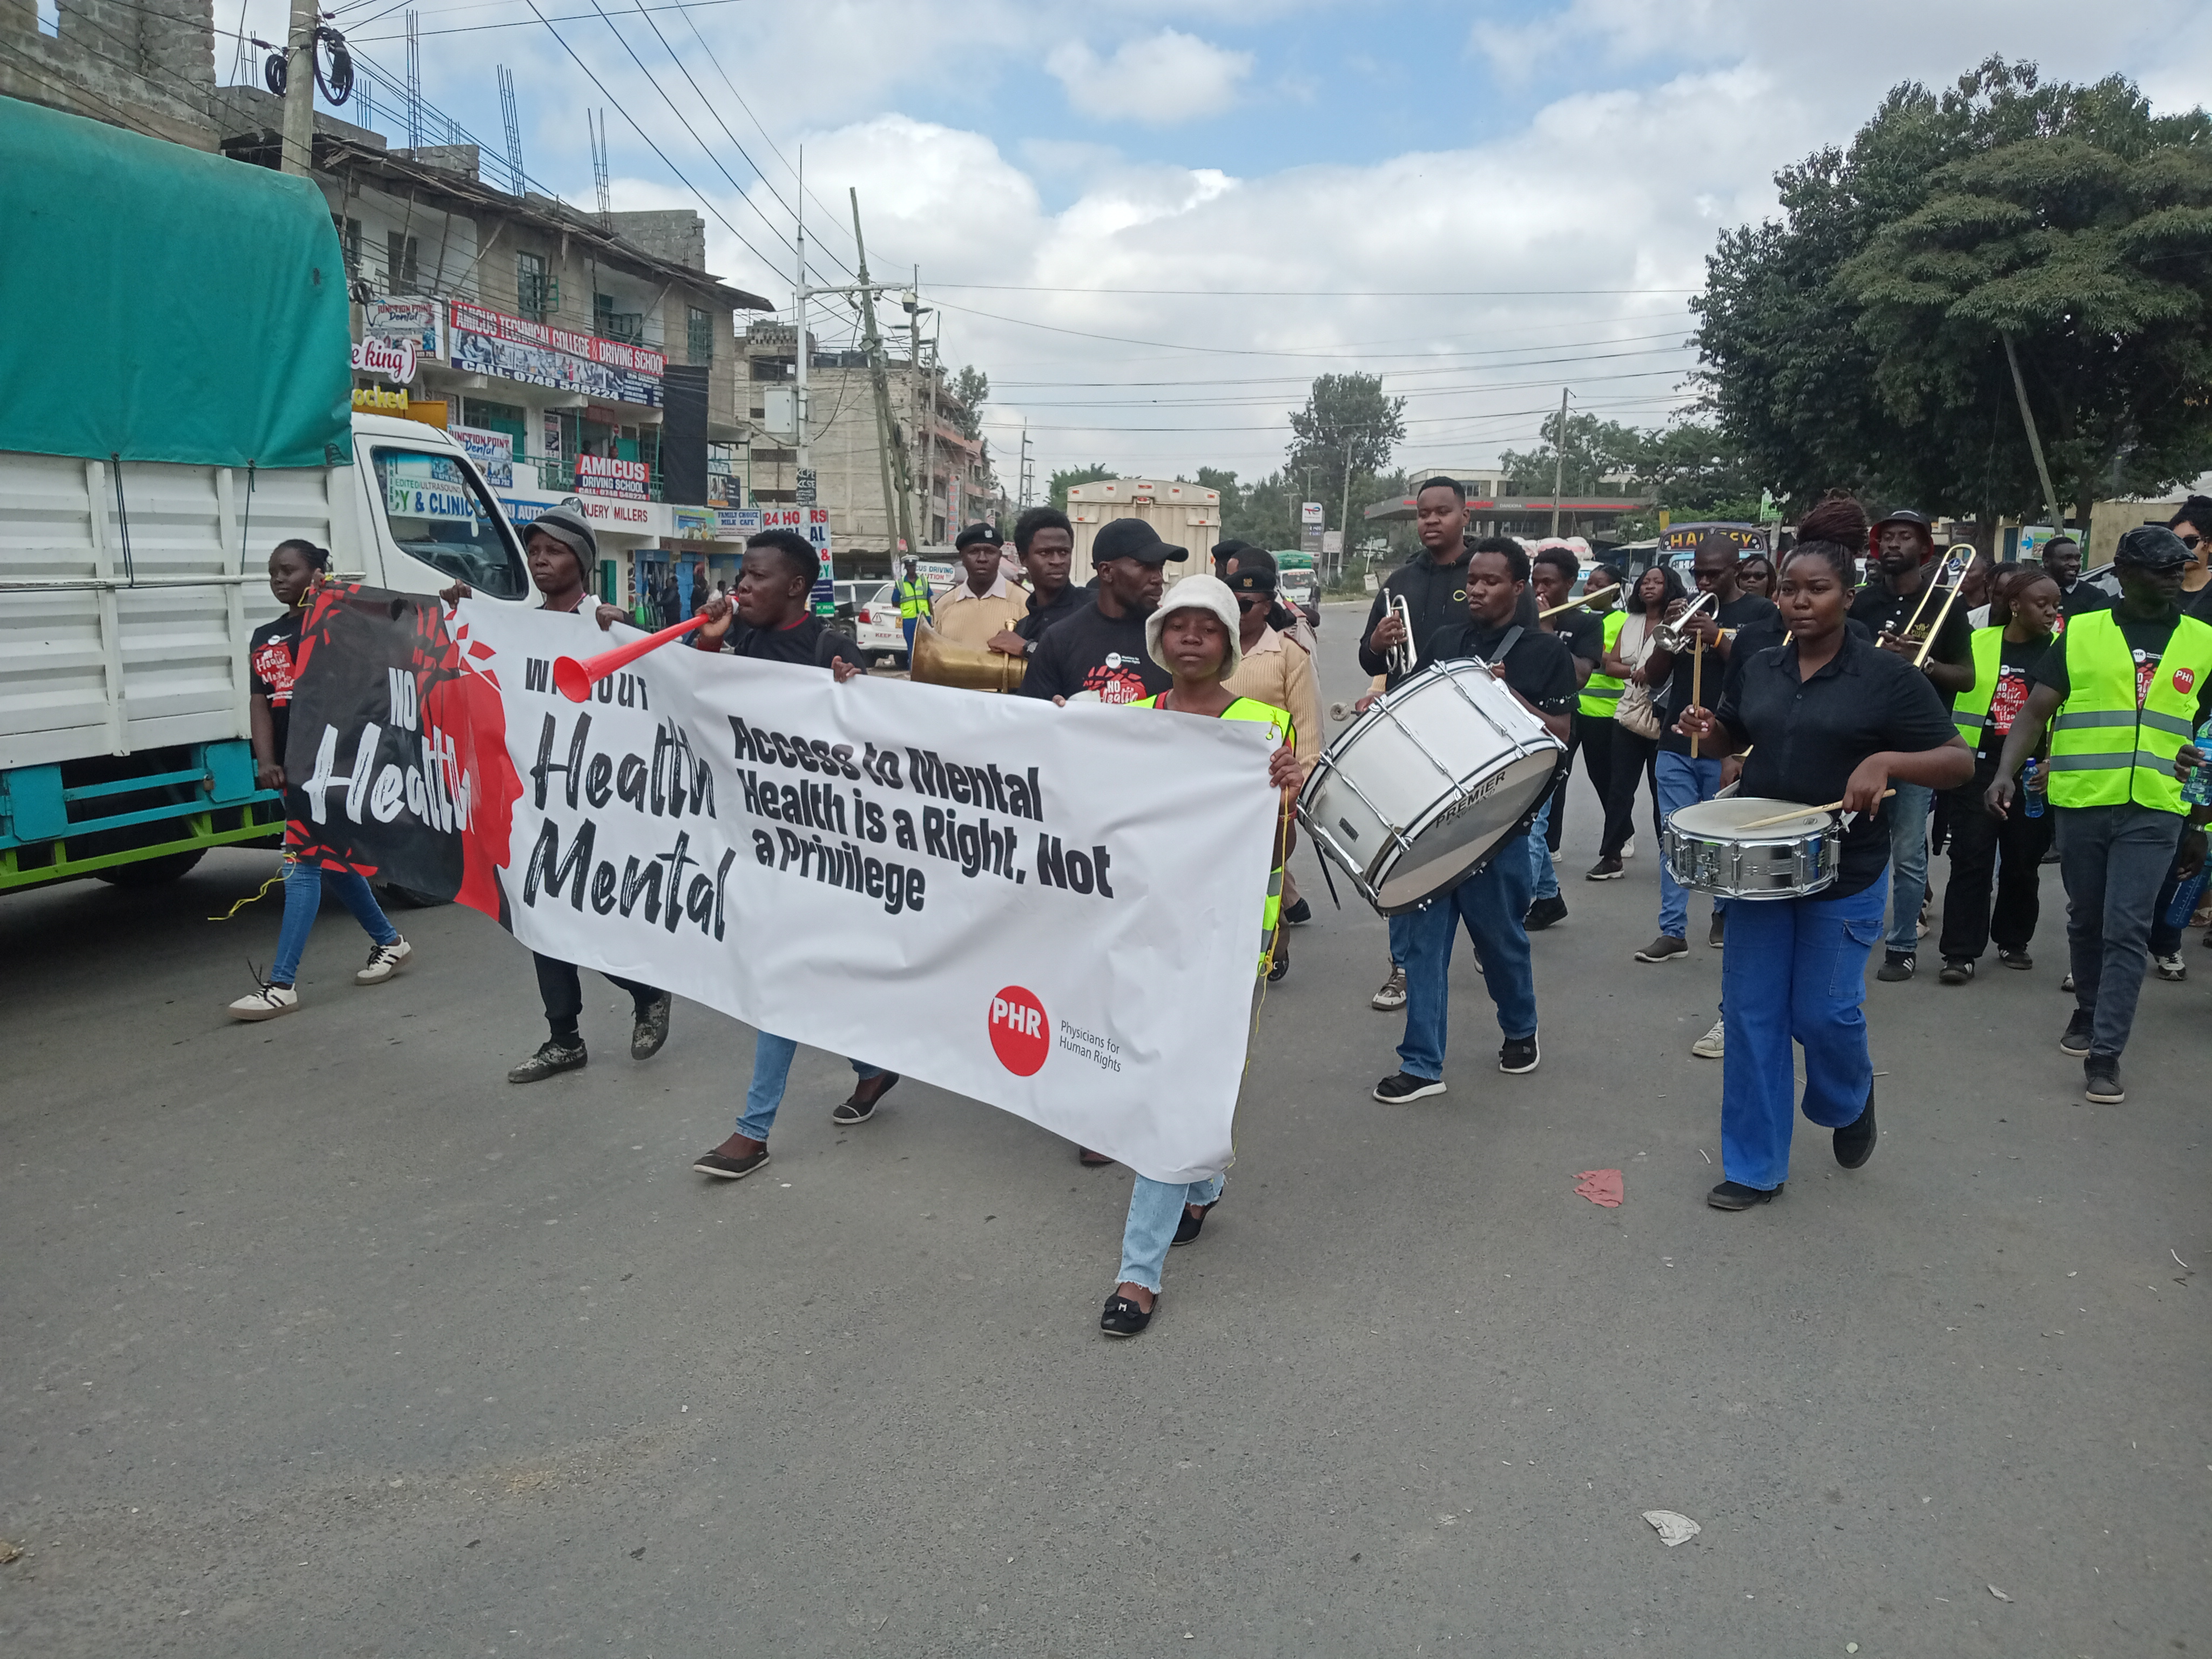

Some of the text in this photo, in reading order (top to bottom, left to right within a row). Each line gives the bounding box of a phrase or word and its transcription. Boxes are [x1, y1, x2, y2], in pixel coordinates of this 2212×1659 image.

[389, 312, 419, 321] Dental
[456, 304, 664, 375] AMICUS TECHNICAL COLLEGE & DRIVING SCHOOL
[462, 360, 511, 379] CALL:
[514, 371, 556, 388] 0748
[559, 380, 620, 401] 548224
[465, 440, 495, 456] Dental
[488, 437, 510, 448] POINT
[580, 455, 645, 481] AMICUS
[797, 468, 816, 479] KCPE
[421, 482, 461, 494] ULTRASOUND
[582, 475, 644, 494] DRIVING SCHOOL
[797, 480, 816, 489] KCSE
[415, 491, 425, 512] &
[429, 493, 474, 517] CLINIC
[614, 506, 648, 523] MILLERS
[764, 509, 827, 526] 24 HORS
[929, 565, 954, 574] DRIVING
[388, 667, 417, 731] NO
[1107, 679, 1121, 693] NO
[529, 711, 718, 820] Health
[727, 714, 1044, 822] Access to Mental
[736, 768, 848, 836] Health
[854, 787, 887, 844] is
[892, 808, 919, 852] a
[1037, 832, 1114, 899] Not
[523, 817, 737, 942] Mental
[751, 826, 926, 915] a Privilege
[993, 997, 1042, 1039] PHR
[1061, 1020, 1120, 1054] Physicians for
[1060, 1035, 1122, 1073] Human Rights
